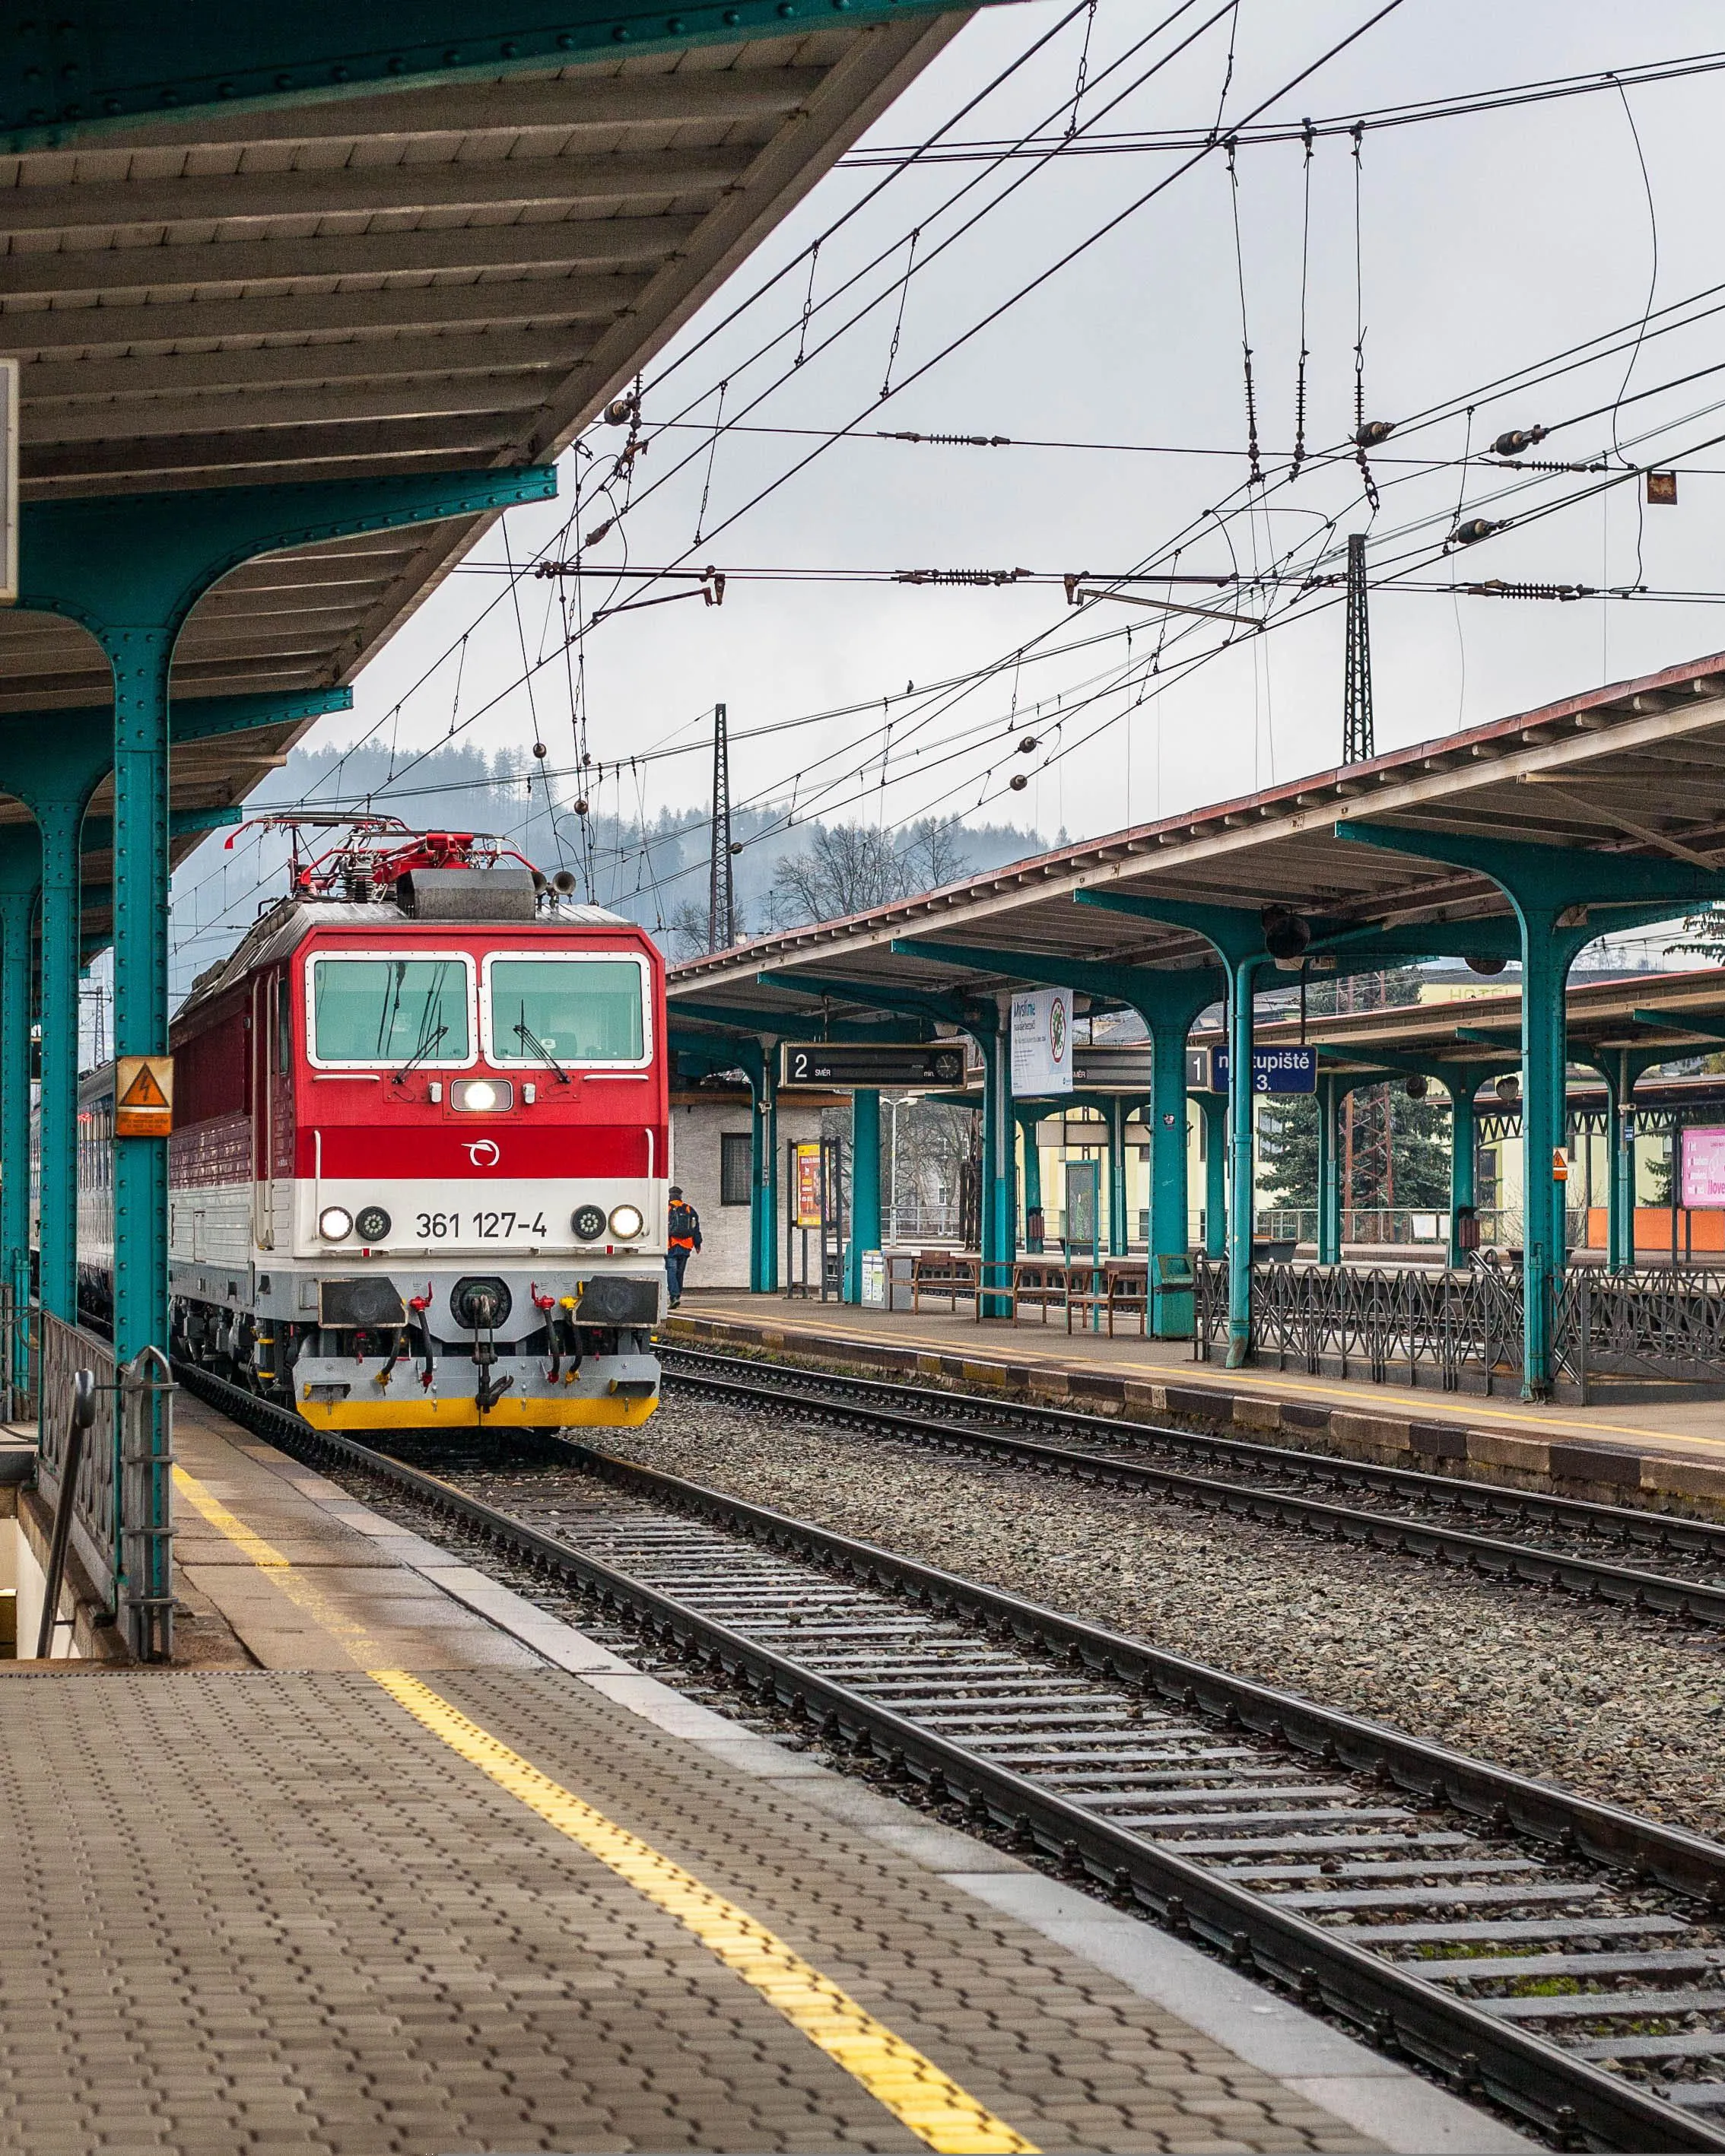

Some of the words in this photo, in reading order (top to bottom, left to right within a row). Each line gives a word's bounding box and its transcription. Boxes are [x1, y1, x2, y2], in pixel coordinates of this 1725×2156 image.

[795, 1054, 808, 1078] 2
[1193, 1057, 1201, 1081] 1
[1218, 1053, 1310, 1072] nupiště
[1072, 1069, 1086, 1078] MĚR
[1256, 1075, 1272, 1091] 3.
[416, 1213, 459, 1238] 361
[473, 1211, 547, 1238] 127-4
